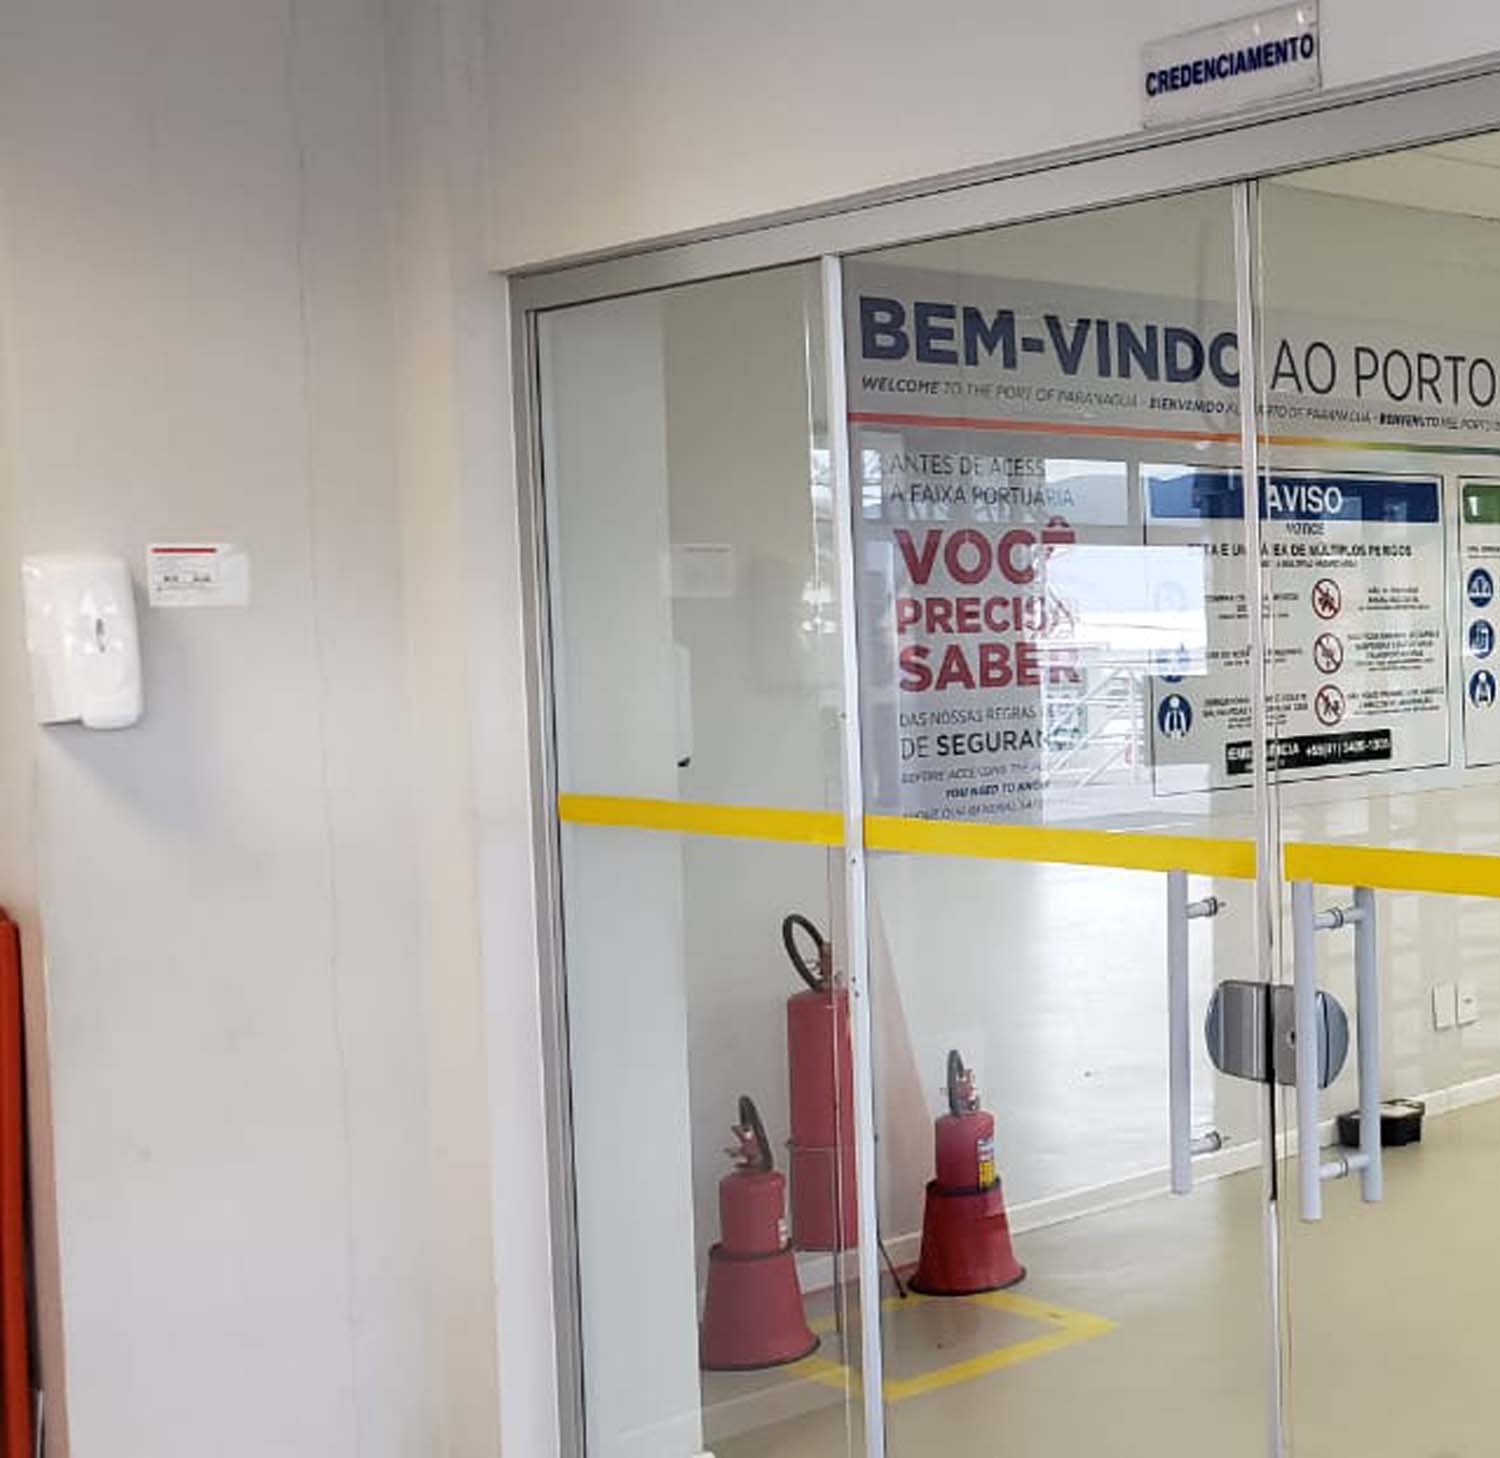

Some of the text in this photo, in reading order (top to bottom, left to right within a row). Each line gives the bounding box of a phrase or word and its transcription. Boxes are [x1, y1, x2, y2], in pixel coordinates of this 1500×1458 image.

[1146, 33, 1314, 97] CREDENCIAMENTO
[859, 296, 1241, 387] BEM-VINDO
[1271, 339, 1336, 396] AO
[1354, 345, 1497, 408] PORTO
[863, 376, 938, 395] WELCOME
[890, 454, 951, 475] ANTES
[992, 458, 1047, 477] ACESS
[911, 484, 967, 503] FAIXA
[1266, 484, 1343, 514] AVISO
[901, 728, 1082, 760] DE SEGURA
